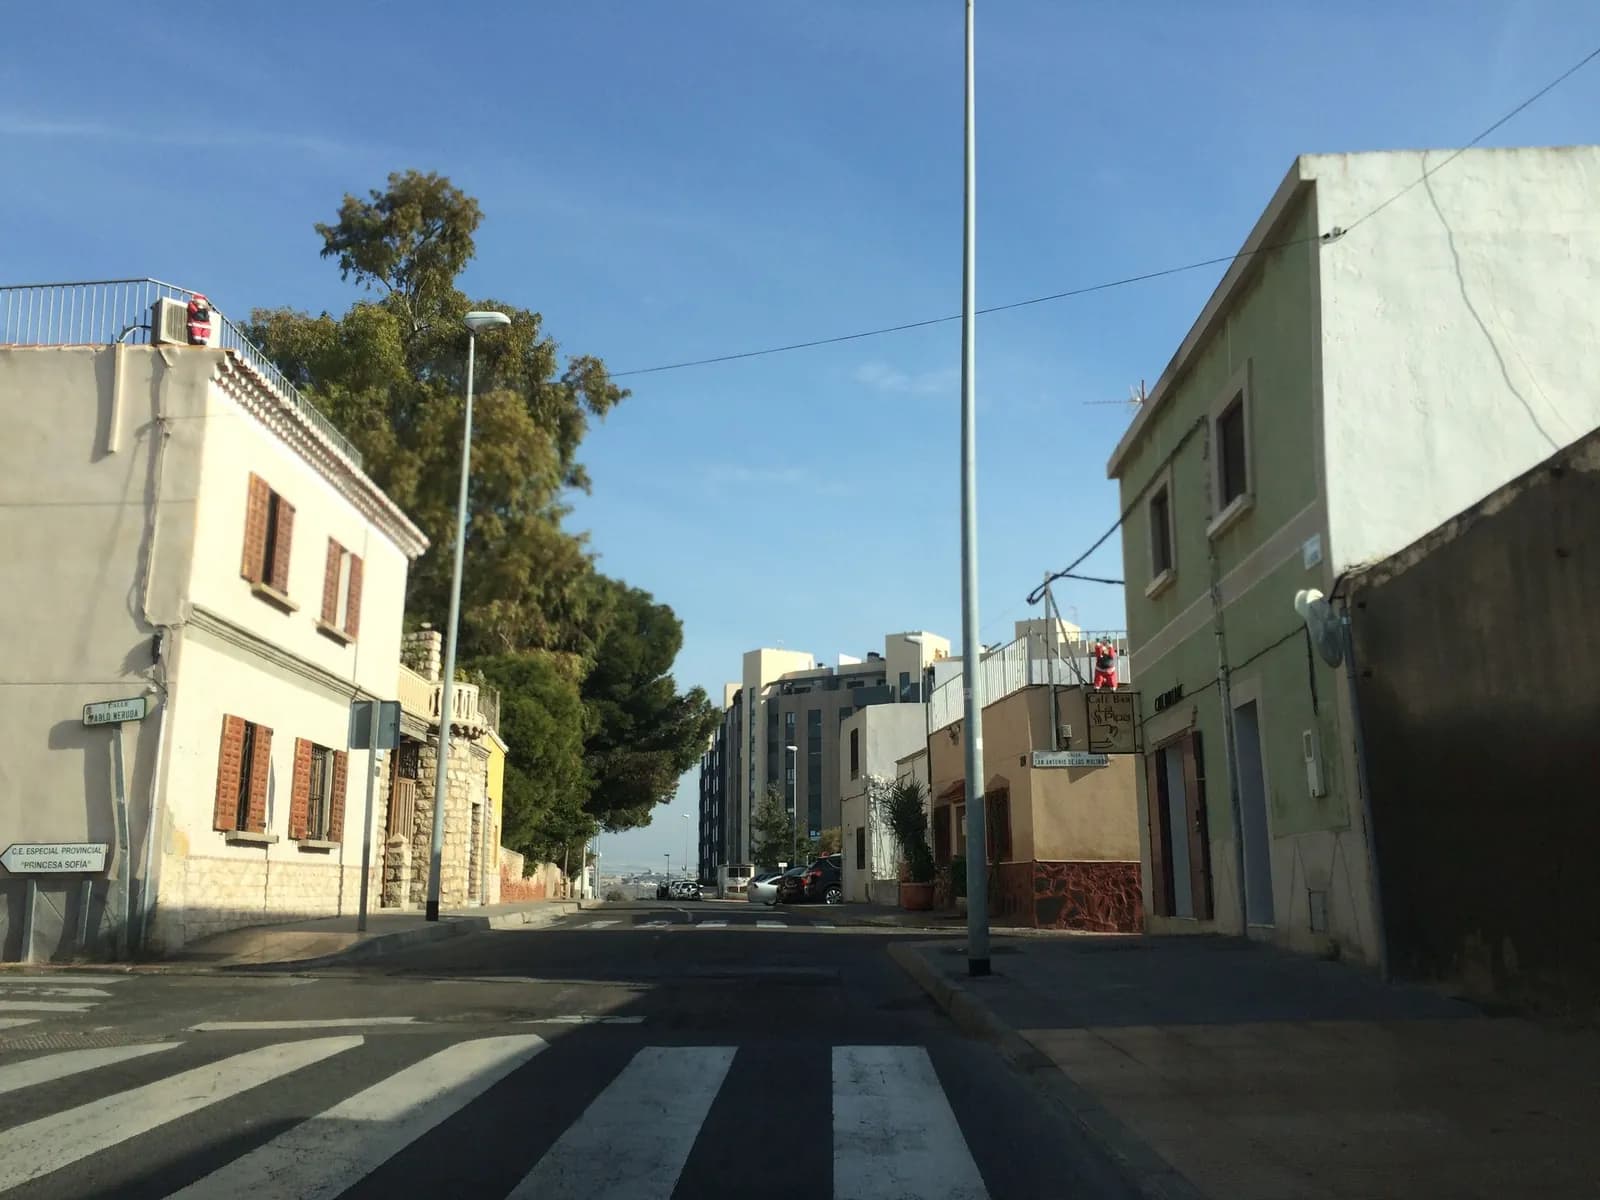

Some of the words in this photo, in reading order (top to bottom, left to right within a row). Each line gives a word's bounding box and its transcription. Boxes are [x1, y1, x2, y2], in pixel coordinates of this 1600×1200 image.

[87, 712, 111, 722] PABLO
[112, 709, 139, 720] NERUDA
[26, 847, 58, 855] ESPECIAL
[61, 846, 102, 854] PROVINCIAL
